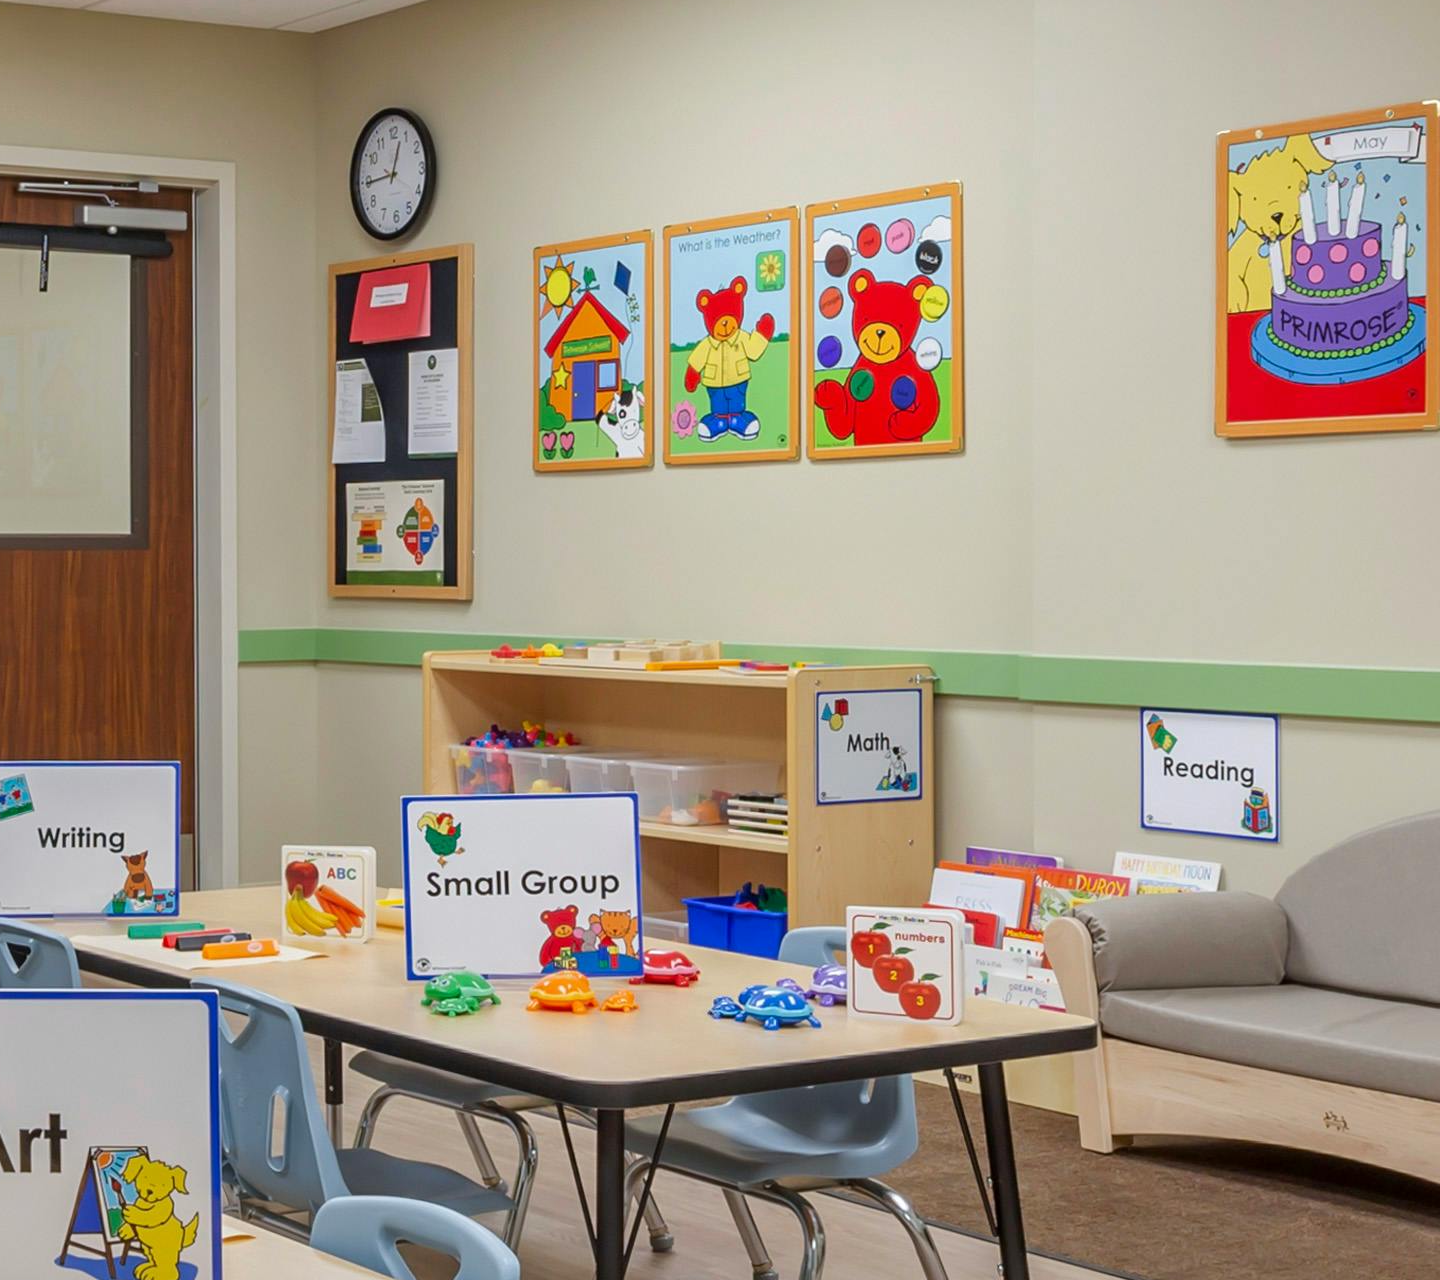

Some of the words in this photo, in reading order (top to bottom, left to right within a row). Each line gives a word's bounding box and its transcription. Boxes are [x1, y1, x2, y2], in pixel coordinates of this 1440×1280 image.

[389, 126, 399, 140] 12
[404, 131, 408, 142] 1
[377, 137, 385, 150] 11
[414, 141, 420, 154] 2
[1353, 135, 1388, 151] May
[369, 152, 378, 166] 10
[419, 161, 425, 175] 3
[415, 184, 421, 194] 4
[370, 194, 376, 208] 8
[406, 201, 412, 215] 5
[380, 208, 387, 221] 7
[393, 210, 400, 224] 6
[678, 241, 703, 253] What
[705, 238, 712, 250] is
[714, 237, 730, 248] the
[733, 228, 781, 245] Weather?
[920, 250, 939, 265] black
[846, 732, 890, 753] Math
[1163, 756, 1255, 788] Reading
[38, 826, 125, 853] Writing
[327, 867, 357, 880] ABC
[1121, 857, 1146, 876] HAPPY
[1183, 863, 1212, 881] MOON
[426, 870, 510, 897] Small
[521, 869, 620, 900] Group
[1076, 874, 1127, 898] DUROY
[955, 895, 993, 912] PRESS
[894, 932, 945, 944] numbers
[868, 944, 874, 955] 1
[890, 970, 897, 981] 2
[1009, 983, 1034, 994] DREAM
[1035, 986, 1048, 999] BIG
[916, 995, 924, 1006] 3
